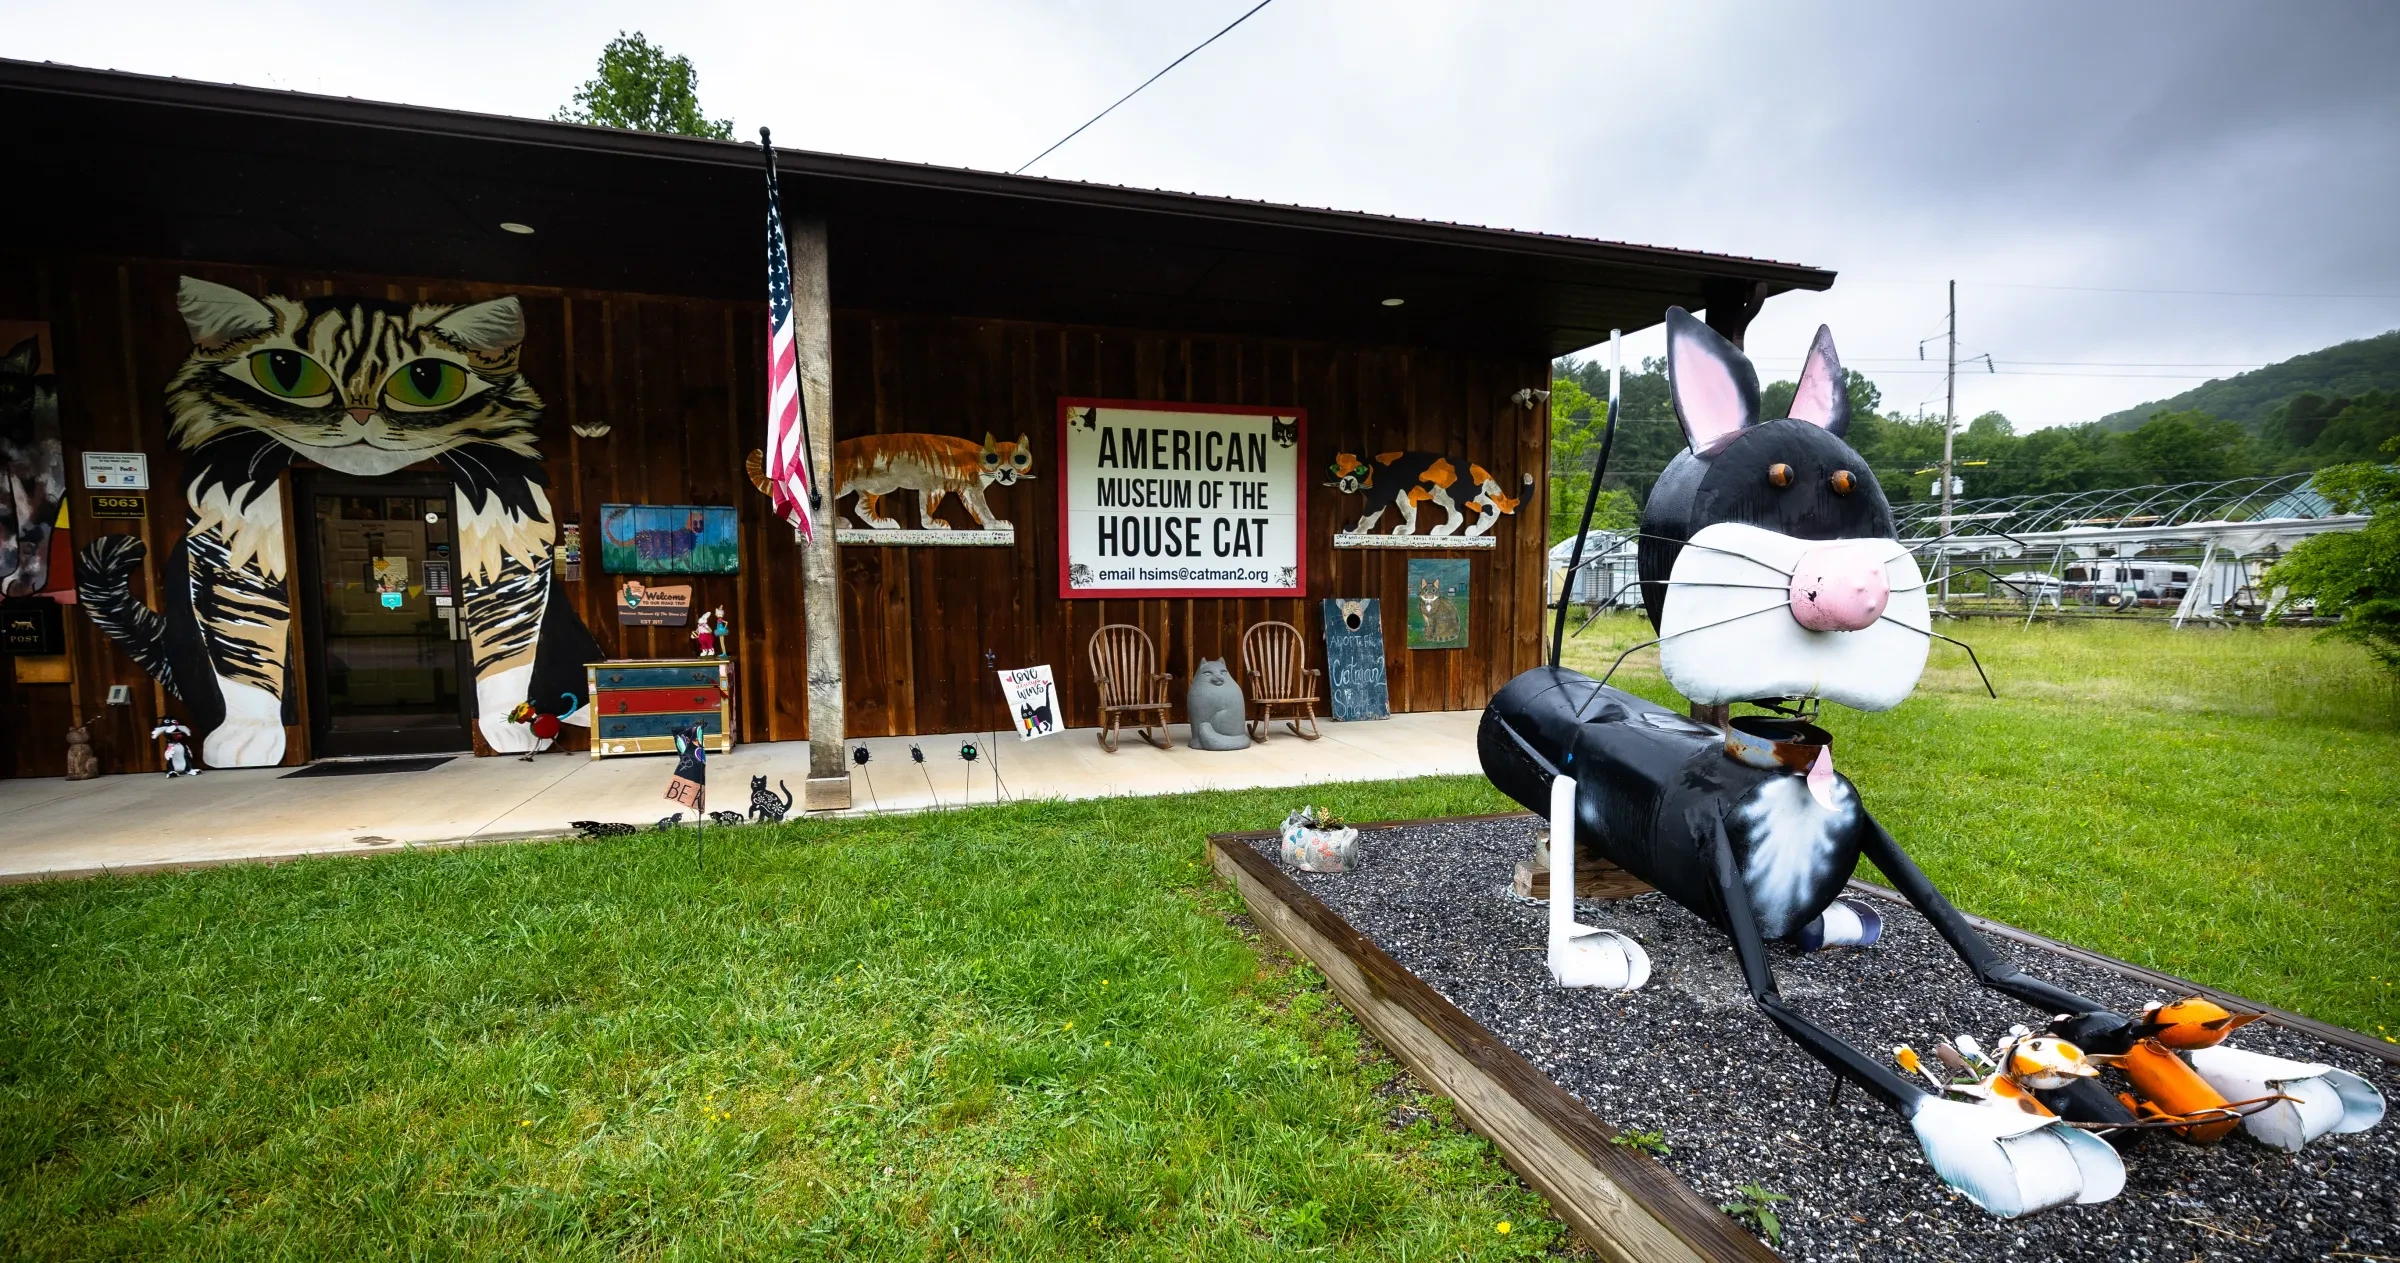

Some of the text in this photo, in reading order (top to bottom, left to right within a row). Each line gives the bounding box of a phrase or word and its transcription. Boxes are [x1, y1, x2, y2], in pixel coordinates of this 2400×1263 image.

[1097, 426, 1267, 473] AMERICAN
[1097, 477, 1269, 510] MUSEUM OF THE
[98, 498, 138, 508] 5063
[1098, 515, 1269, 558] HOUSE CAT
[1098, 567, 1269, 583] email hsims@catman2.org
[645, 591, 687, 601] Welcome
[10, 635, 39, 643] POST
[1329, 635, 1361, 648] ADOPT
[666, 780, 692, 804] BE
